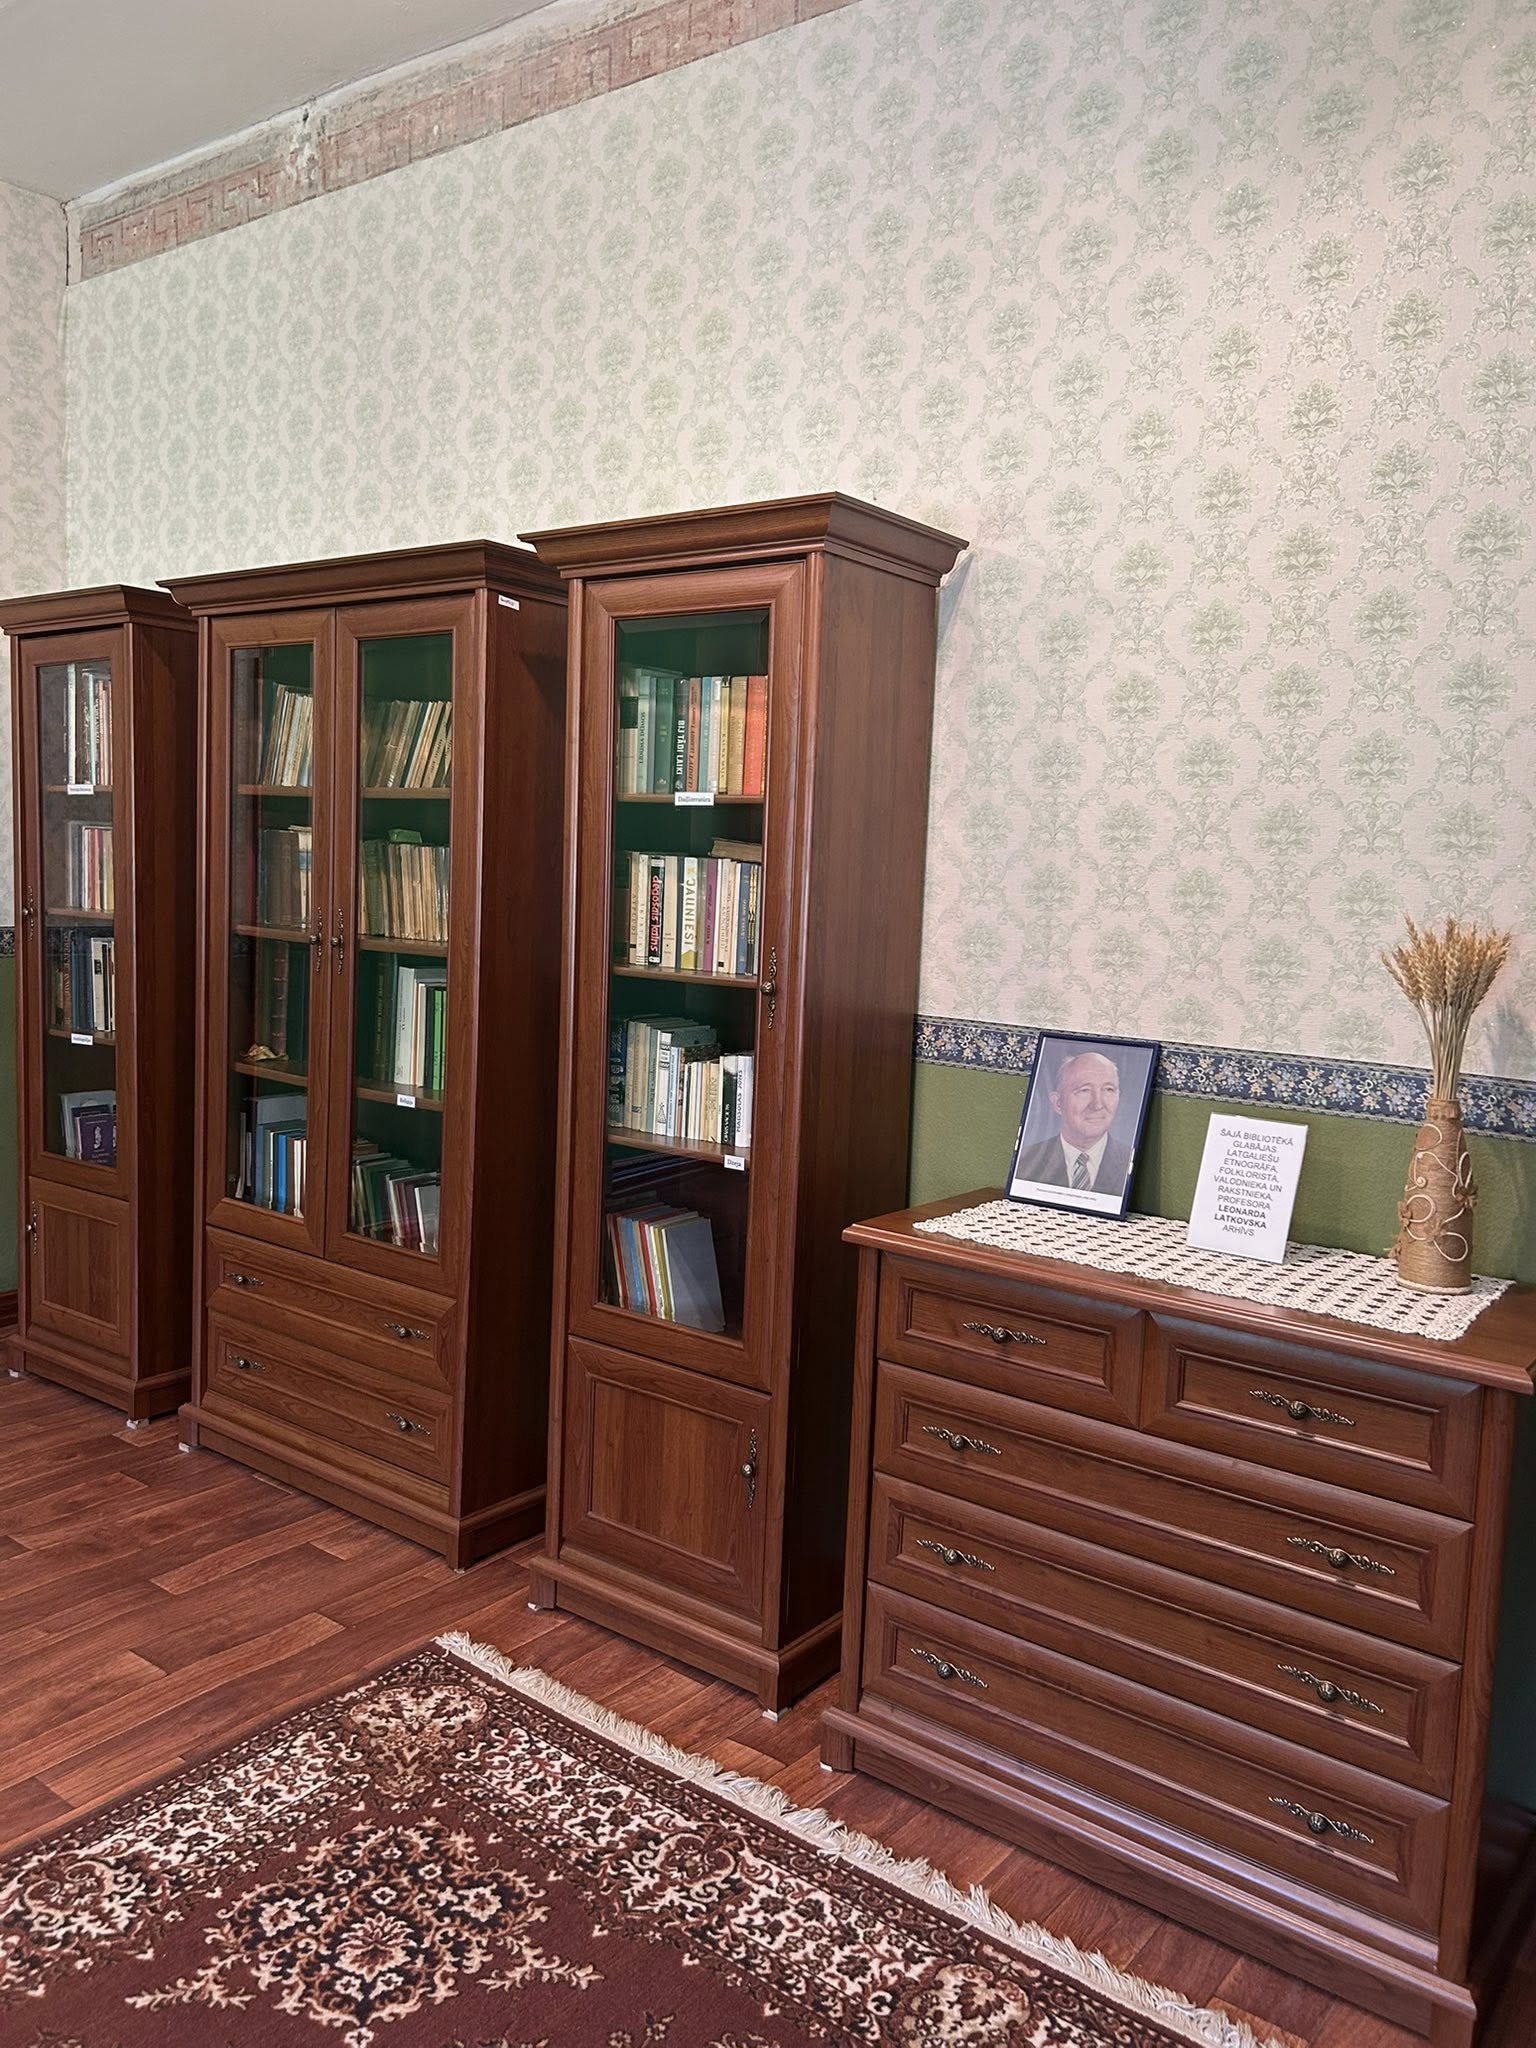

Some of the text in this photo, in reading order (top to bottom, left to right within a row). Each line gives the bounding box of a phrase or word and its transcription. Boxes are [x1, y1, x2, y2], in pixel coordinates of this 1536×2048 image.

[675, 719, 686, 775] BIJ TĀDI LAIKI
[650, 875, 663, 952] degosais kalns
[1220, 1128, 1294, 1146] ŠAJĀ BIBLIOTĒKĀ
[1233, 1140, 1277, 1153] GLABĀJAS
[1227, 1149, 1280, 1163] LATGALIEŠU
[1219, 1166, 1280, 1183] FOLKLORISTA,
[1214, 1175, 1282, 1193] VALODNIEKA UN
[1217, 1194, 1271, 1210] PROFESORA
[1218, 1204, 1266, 1219] LEONARDA
[1214, 1213, 1267, 1229] LATKOVSKA
[1222, 1224, 1255, 1236] ARHĪVS
